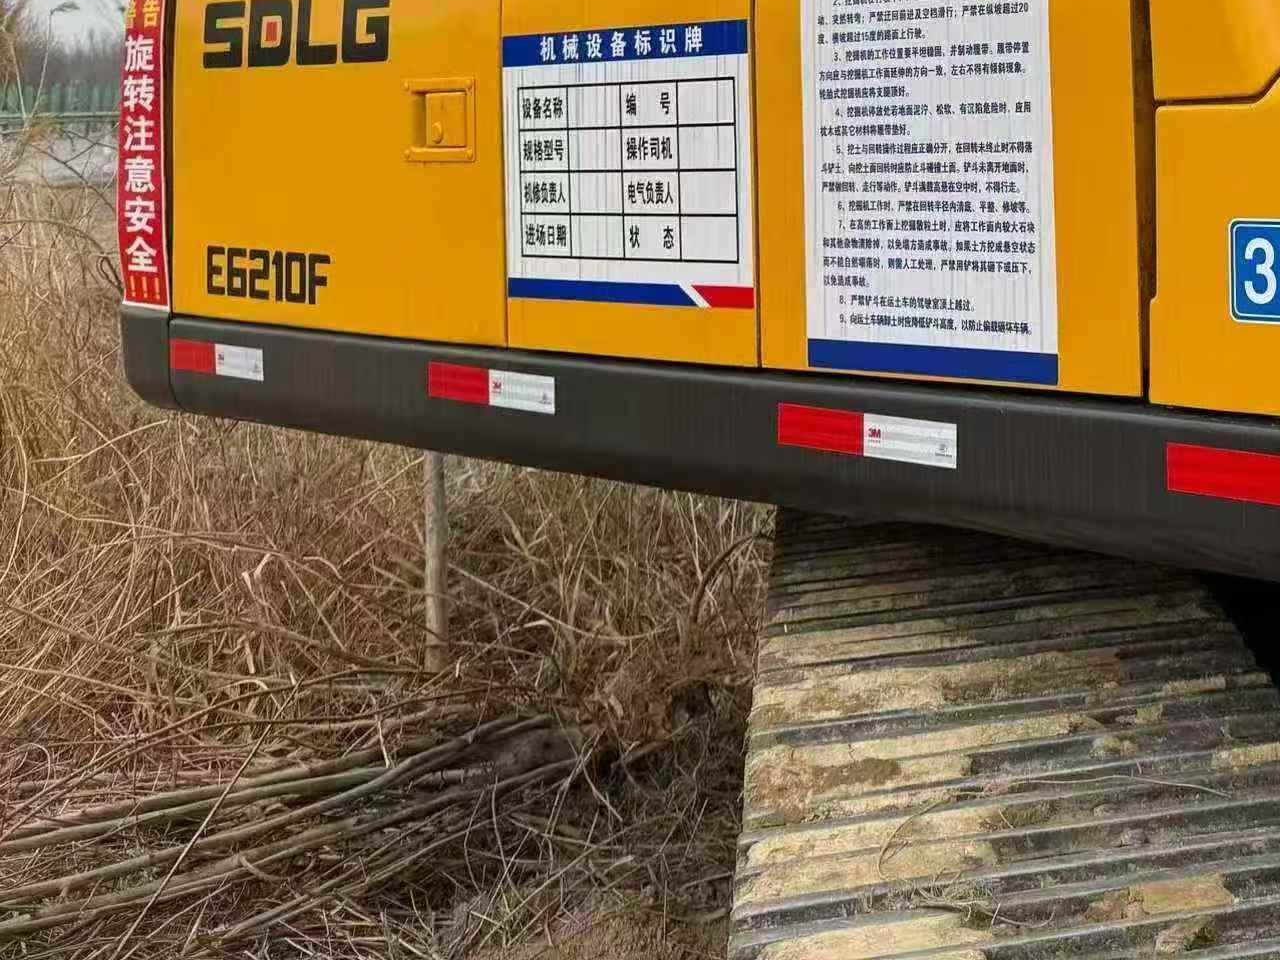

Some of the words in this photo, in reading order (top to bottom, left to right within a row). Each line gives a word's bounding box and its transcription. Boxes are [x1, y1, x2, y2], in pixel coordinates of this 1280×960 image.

[540, 25, 703, 62] 机械设备标识牌
[522, 96, 564, 119] 设备名称
[123, 34, 158, 274] 旋转注意安全
[523, 139, 564, 162] 规格型号
[626, 136, 673, 160] 操作司机
[524, 181, 566, 205] 机修负责人
[627, 181, 674, 205] 电气负责人
[525, 224, 567, 247] 进场日期
[206, 245, 332, 305] E6210F
